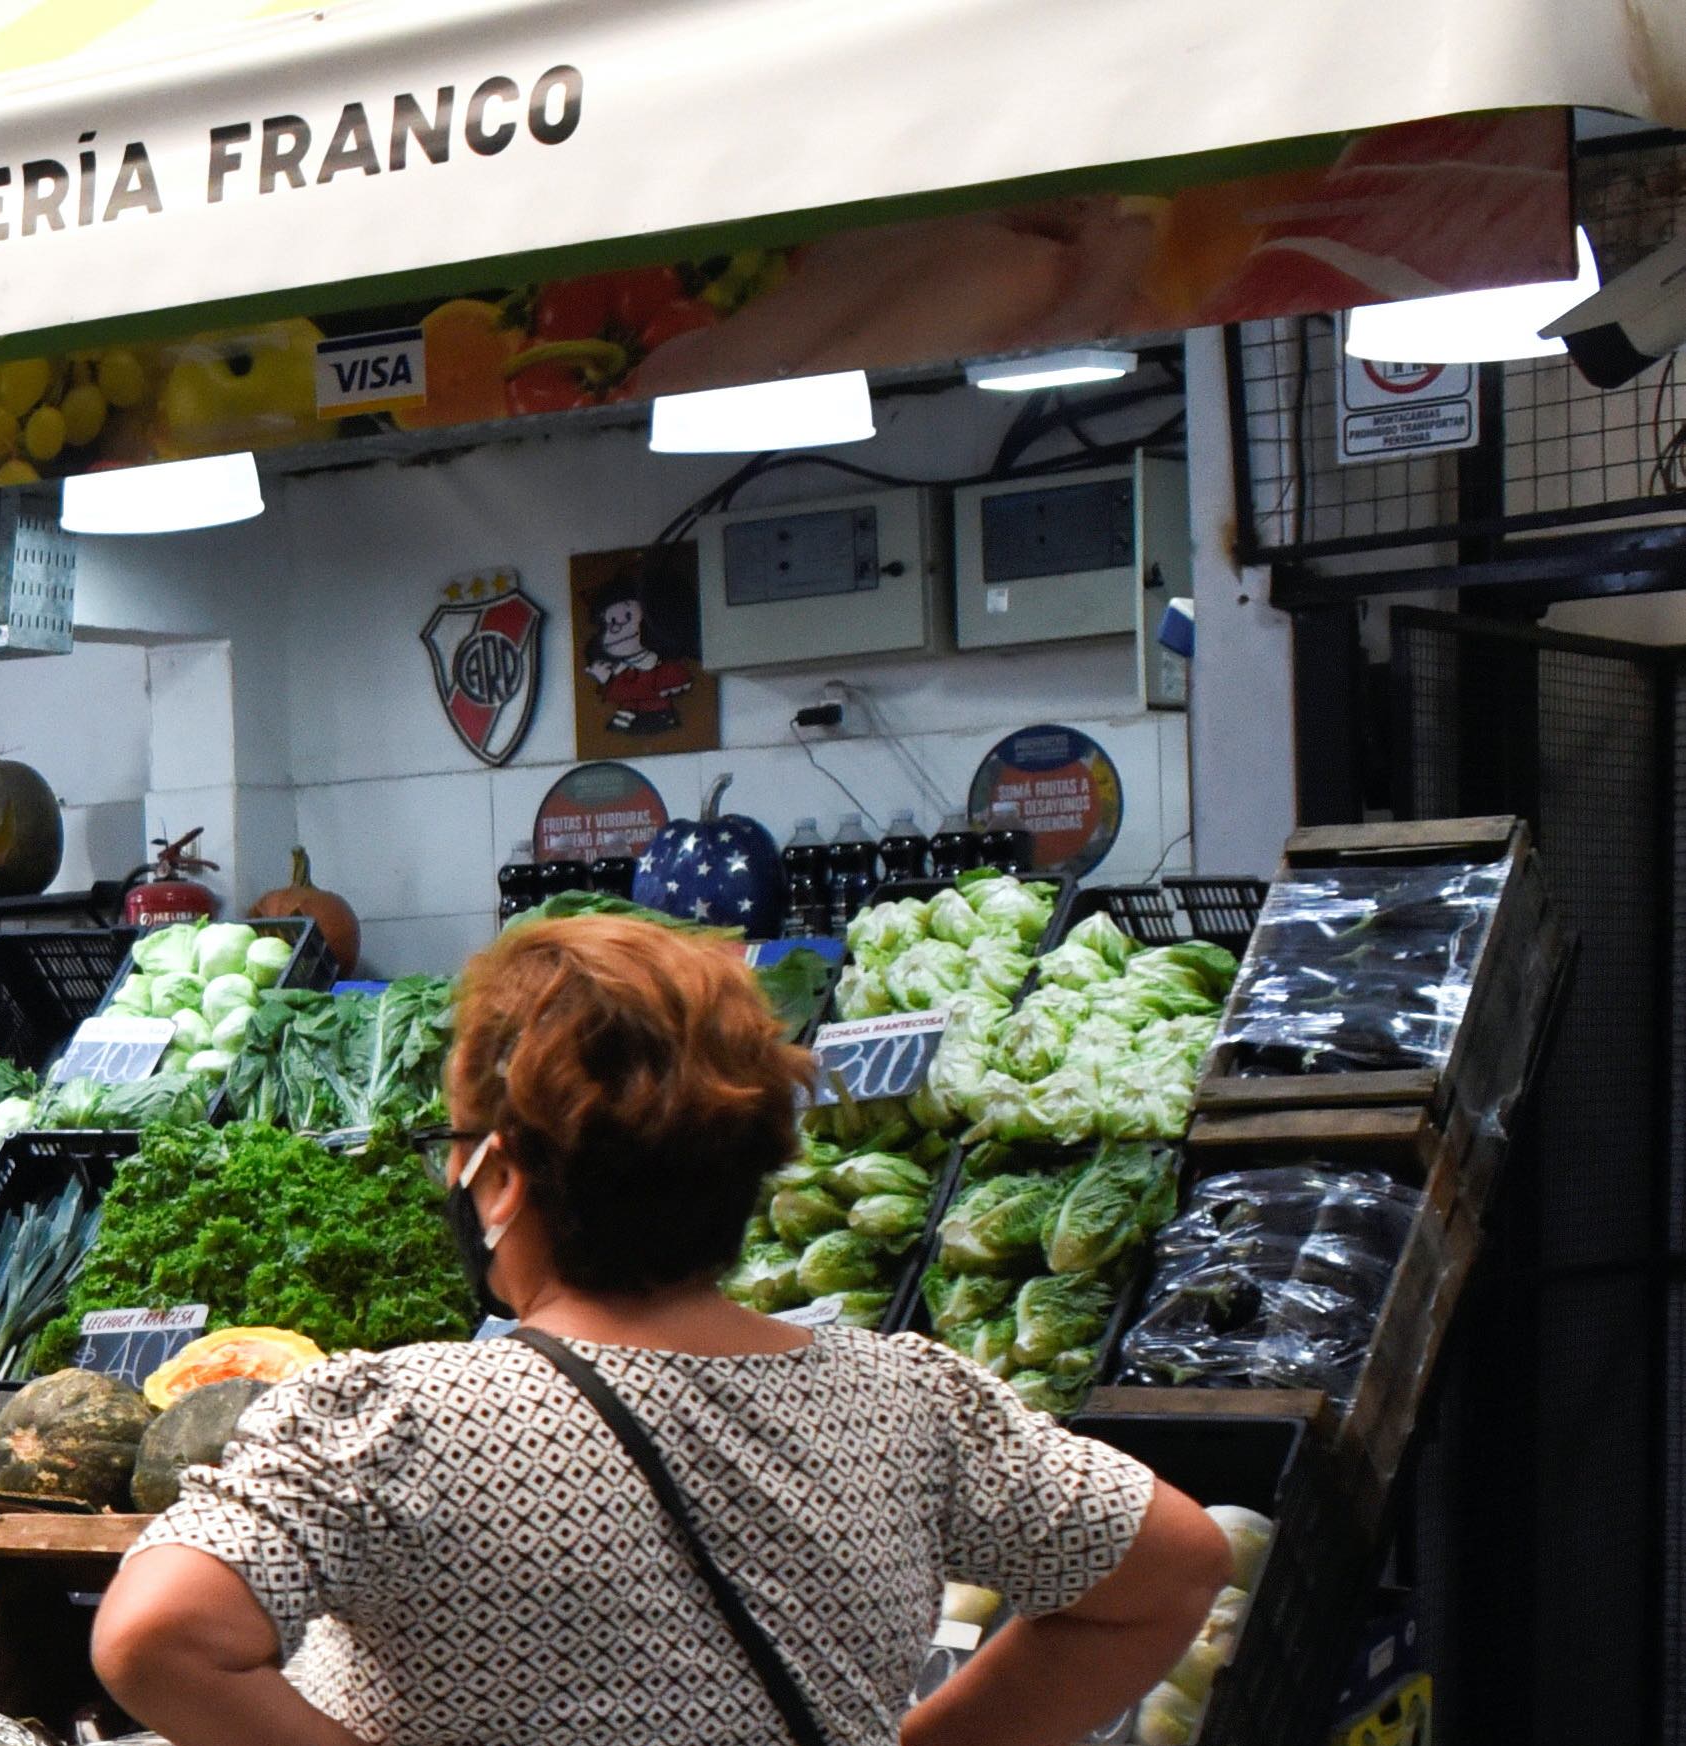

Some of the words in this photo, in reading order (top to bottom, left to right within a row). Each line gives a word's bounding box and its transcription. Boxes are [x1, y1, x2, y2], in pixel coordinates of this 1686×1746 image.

[205, 63, 585, 203] FRANCO
[330, 354, 412, 393] VISA
[874, 1016, 945, 1032] MANTECOSA
[86, 1314, 133, 1331] LECHUGA
